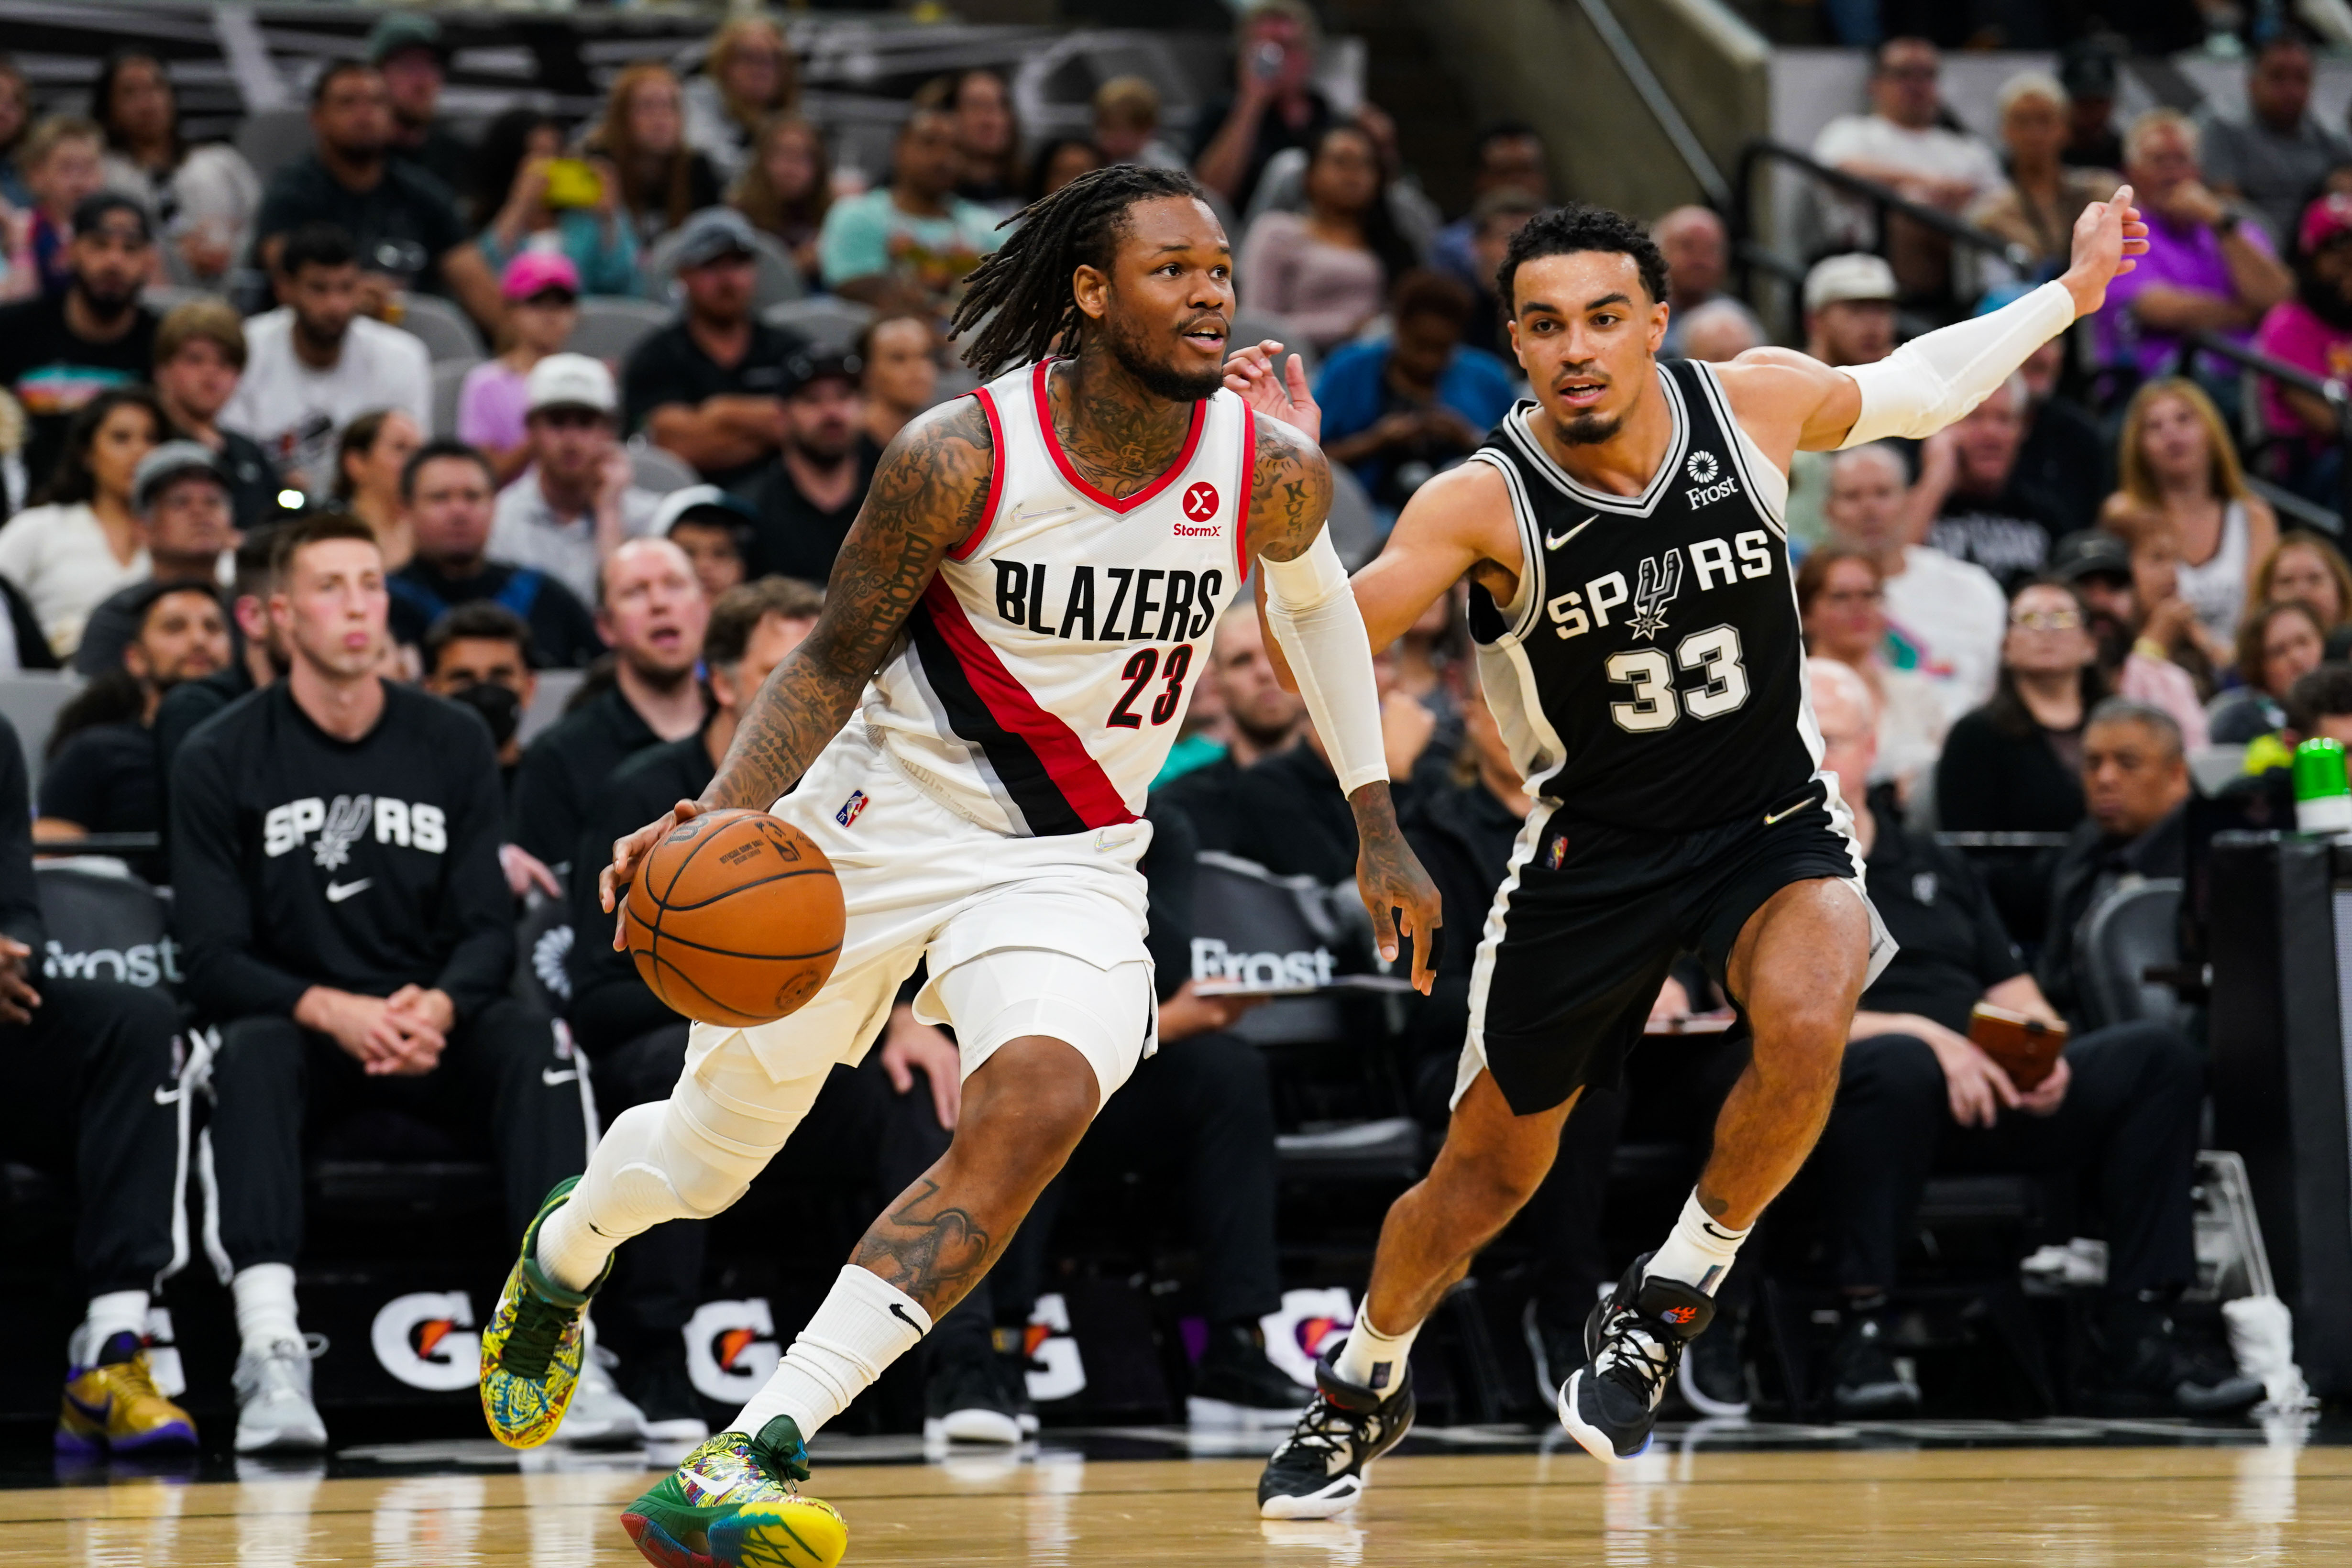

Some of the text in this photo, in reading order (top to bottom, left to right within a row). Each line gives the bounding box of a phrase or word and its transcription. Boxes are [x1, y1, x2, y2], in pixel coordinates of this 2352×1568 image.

[1174, 523, 1222, 537] StormX
[1685, 475, 1739, 511] Frost
[990, 559, 1222, 642] BLAZERS
[1547, 529, 1772, 641] SPURS
[1106, 644, 1193, 729] 23
[1604, 623, 1750, 734] 33
[264, 793, 448, 872] SPURS
[1190, 936, 1339, 988] Frost
[371, 1290, 481, 1391] G
[681, 1297, 783, 1405] G
